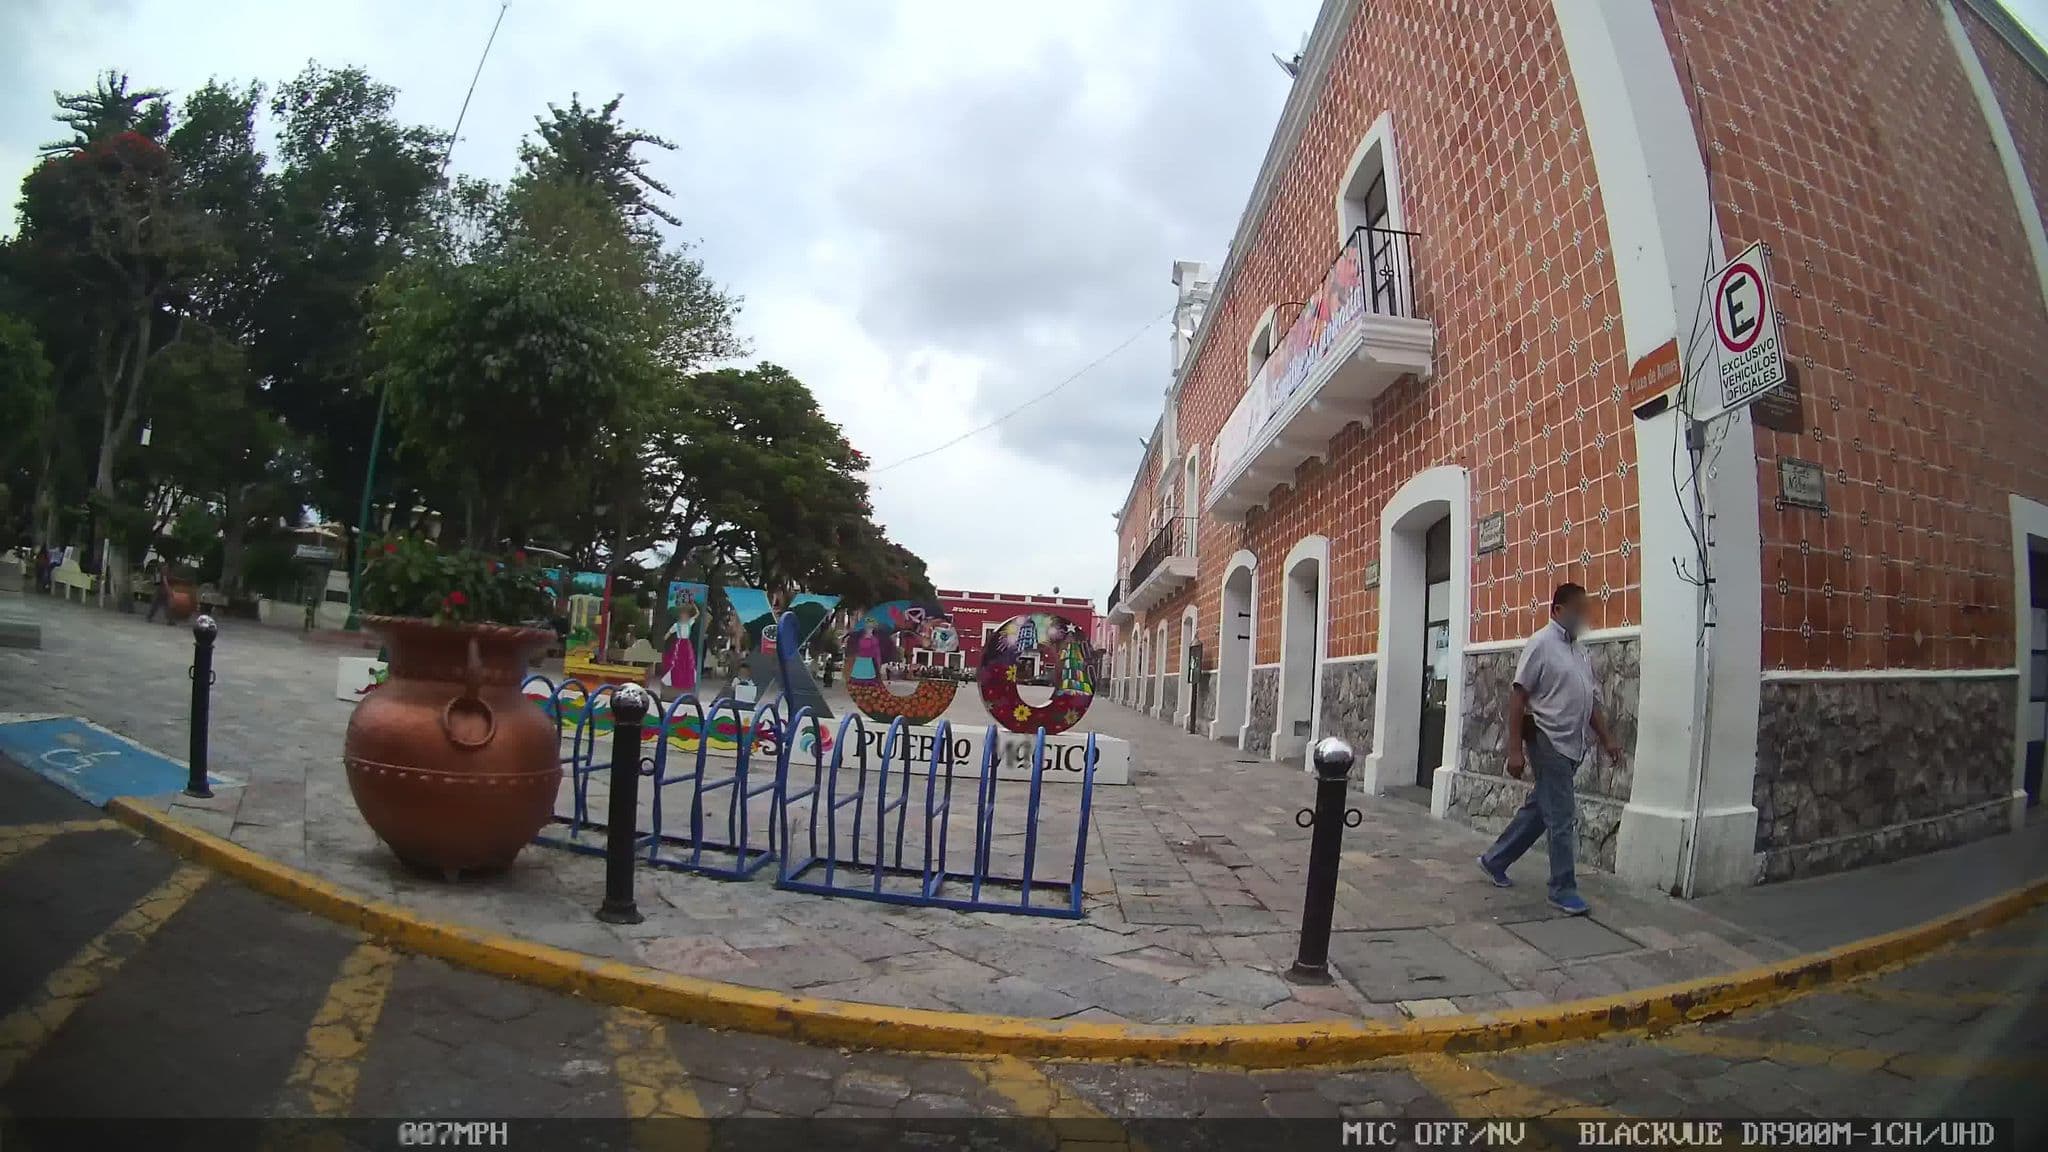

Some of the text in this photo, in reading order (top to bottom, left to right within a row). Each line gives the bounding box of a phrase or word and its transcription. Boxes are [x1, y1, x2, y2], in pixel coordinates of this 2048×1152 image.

[1725, 275, 1756, 339] E
[1722, 338, 1775, 376] EXCLUSIVO
[1723, 352, 1777, 389] VEHICULOS
[1725, 367, 1777, 401] OFICIALES
